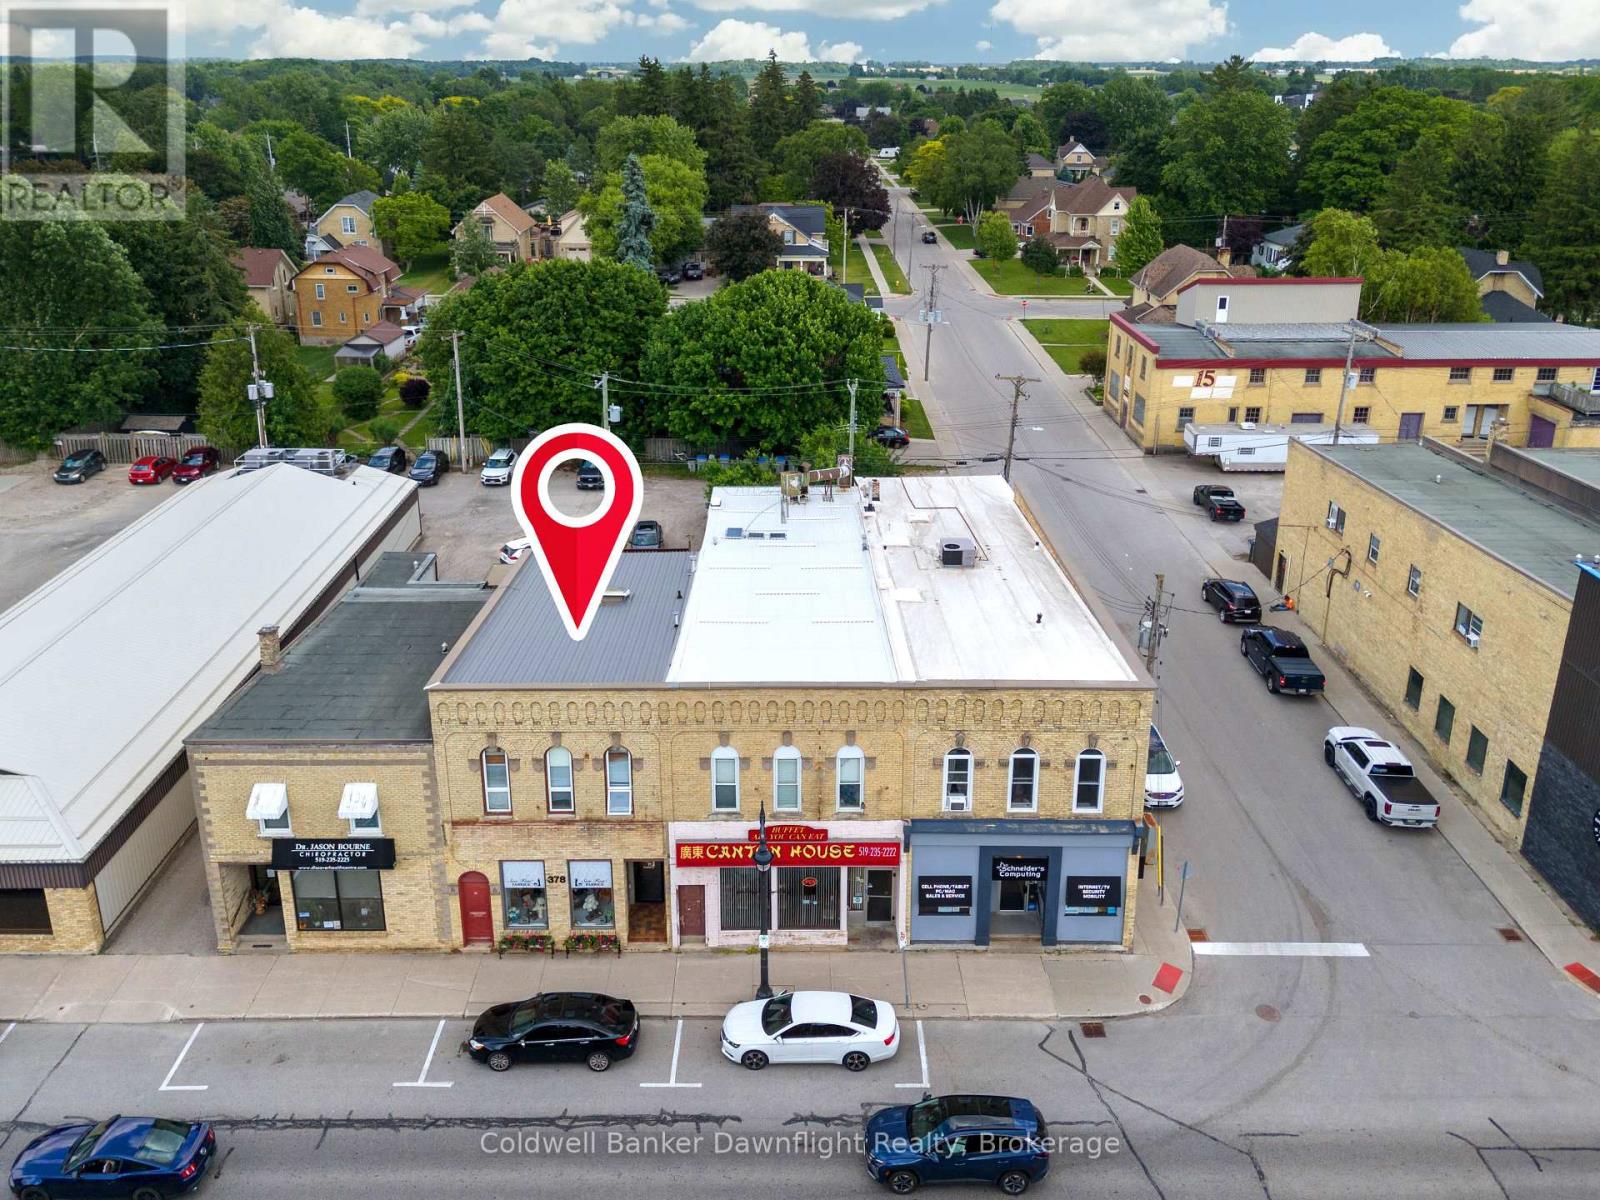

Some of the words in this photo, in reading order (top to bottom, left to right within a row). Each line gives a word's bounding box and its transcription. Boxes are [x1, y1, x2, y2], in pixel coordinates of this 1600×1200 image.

[1194, 369, 1216, 387] 15
[706, 845, 781, 859] CANTN
[790, 844, 856, 859] HOUSE
[858, 846, 897, 857] 519-235-2222
[546, 875, 566, 883] 378
